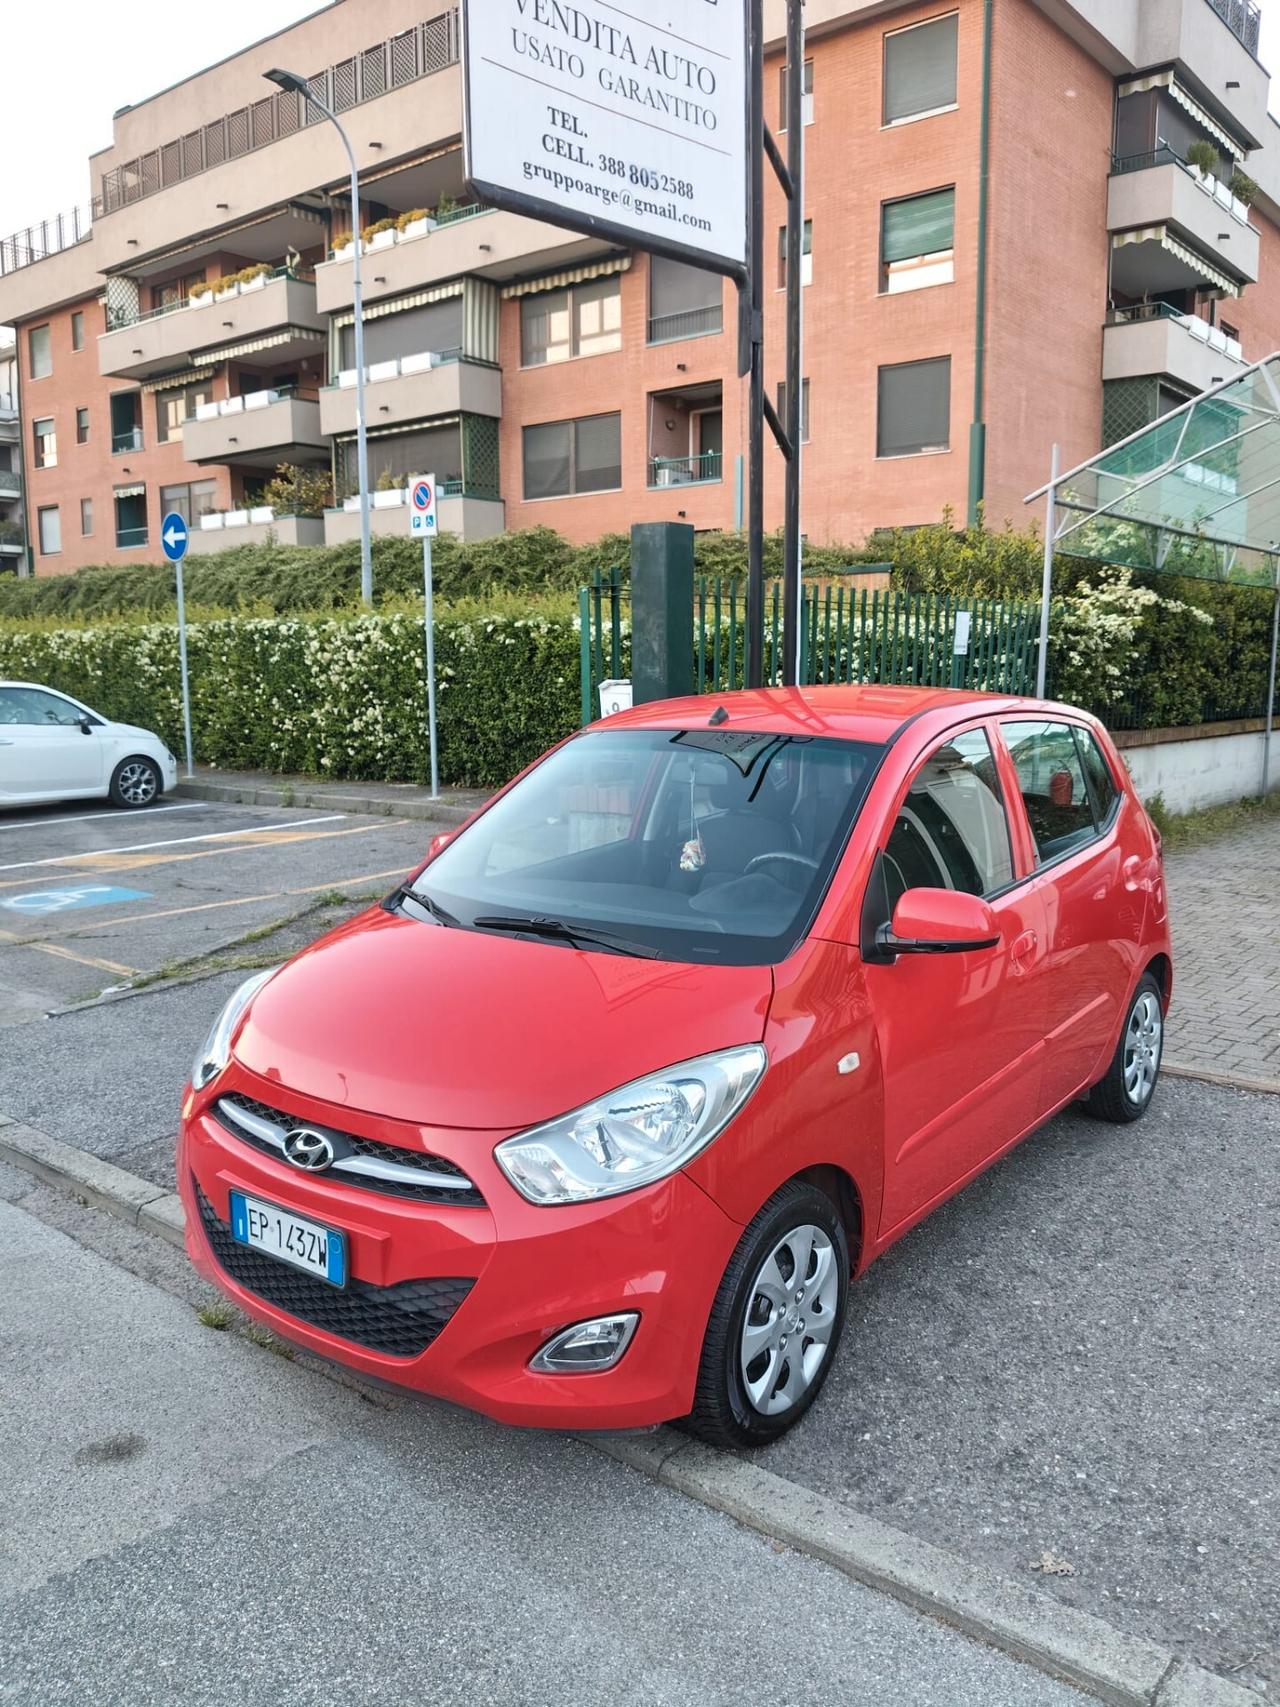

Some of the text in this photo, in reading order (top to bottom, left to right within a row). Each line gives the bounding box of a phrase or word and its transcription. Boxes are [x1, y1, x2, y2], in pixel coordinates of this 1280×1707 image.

[511, 27, 717, 131] USATO GARANTITO
[643, 45, 717, 96] AUTO
[547, 106, 588, 138] TEL.
[542, 133, 594, 168] CELL.
[598, 154, 626, 178] 388
[523, 161, 712, 232] gruppoarge@gmail.com
[248, 1208, 269, 1241] EP
